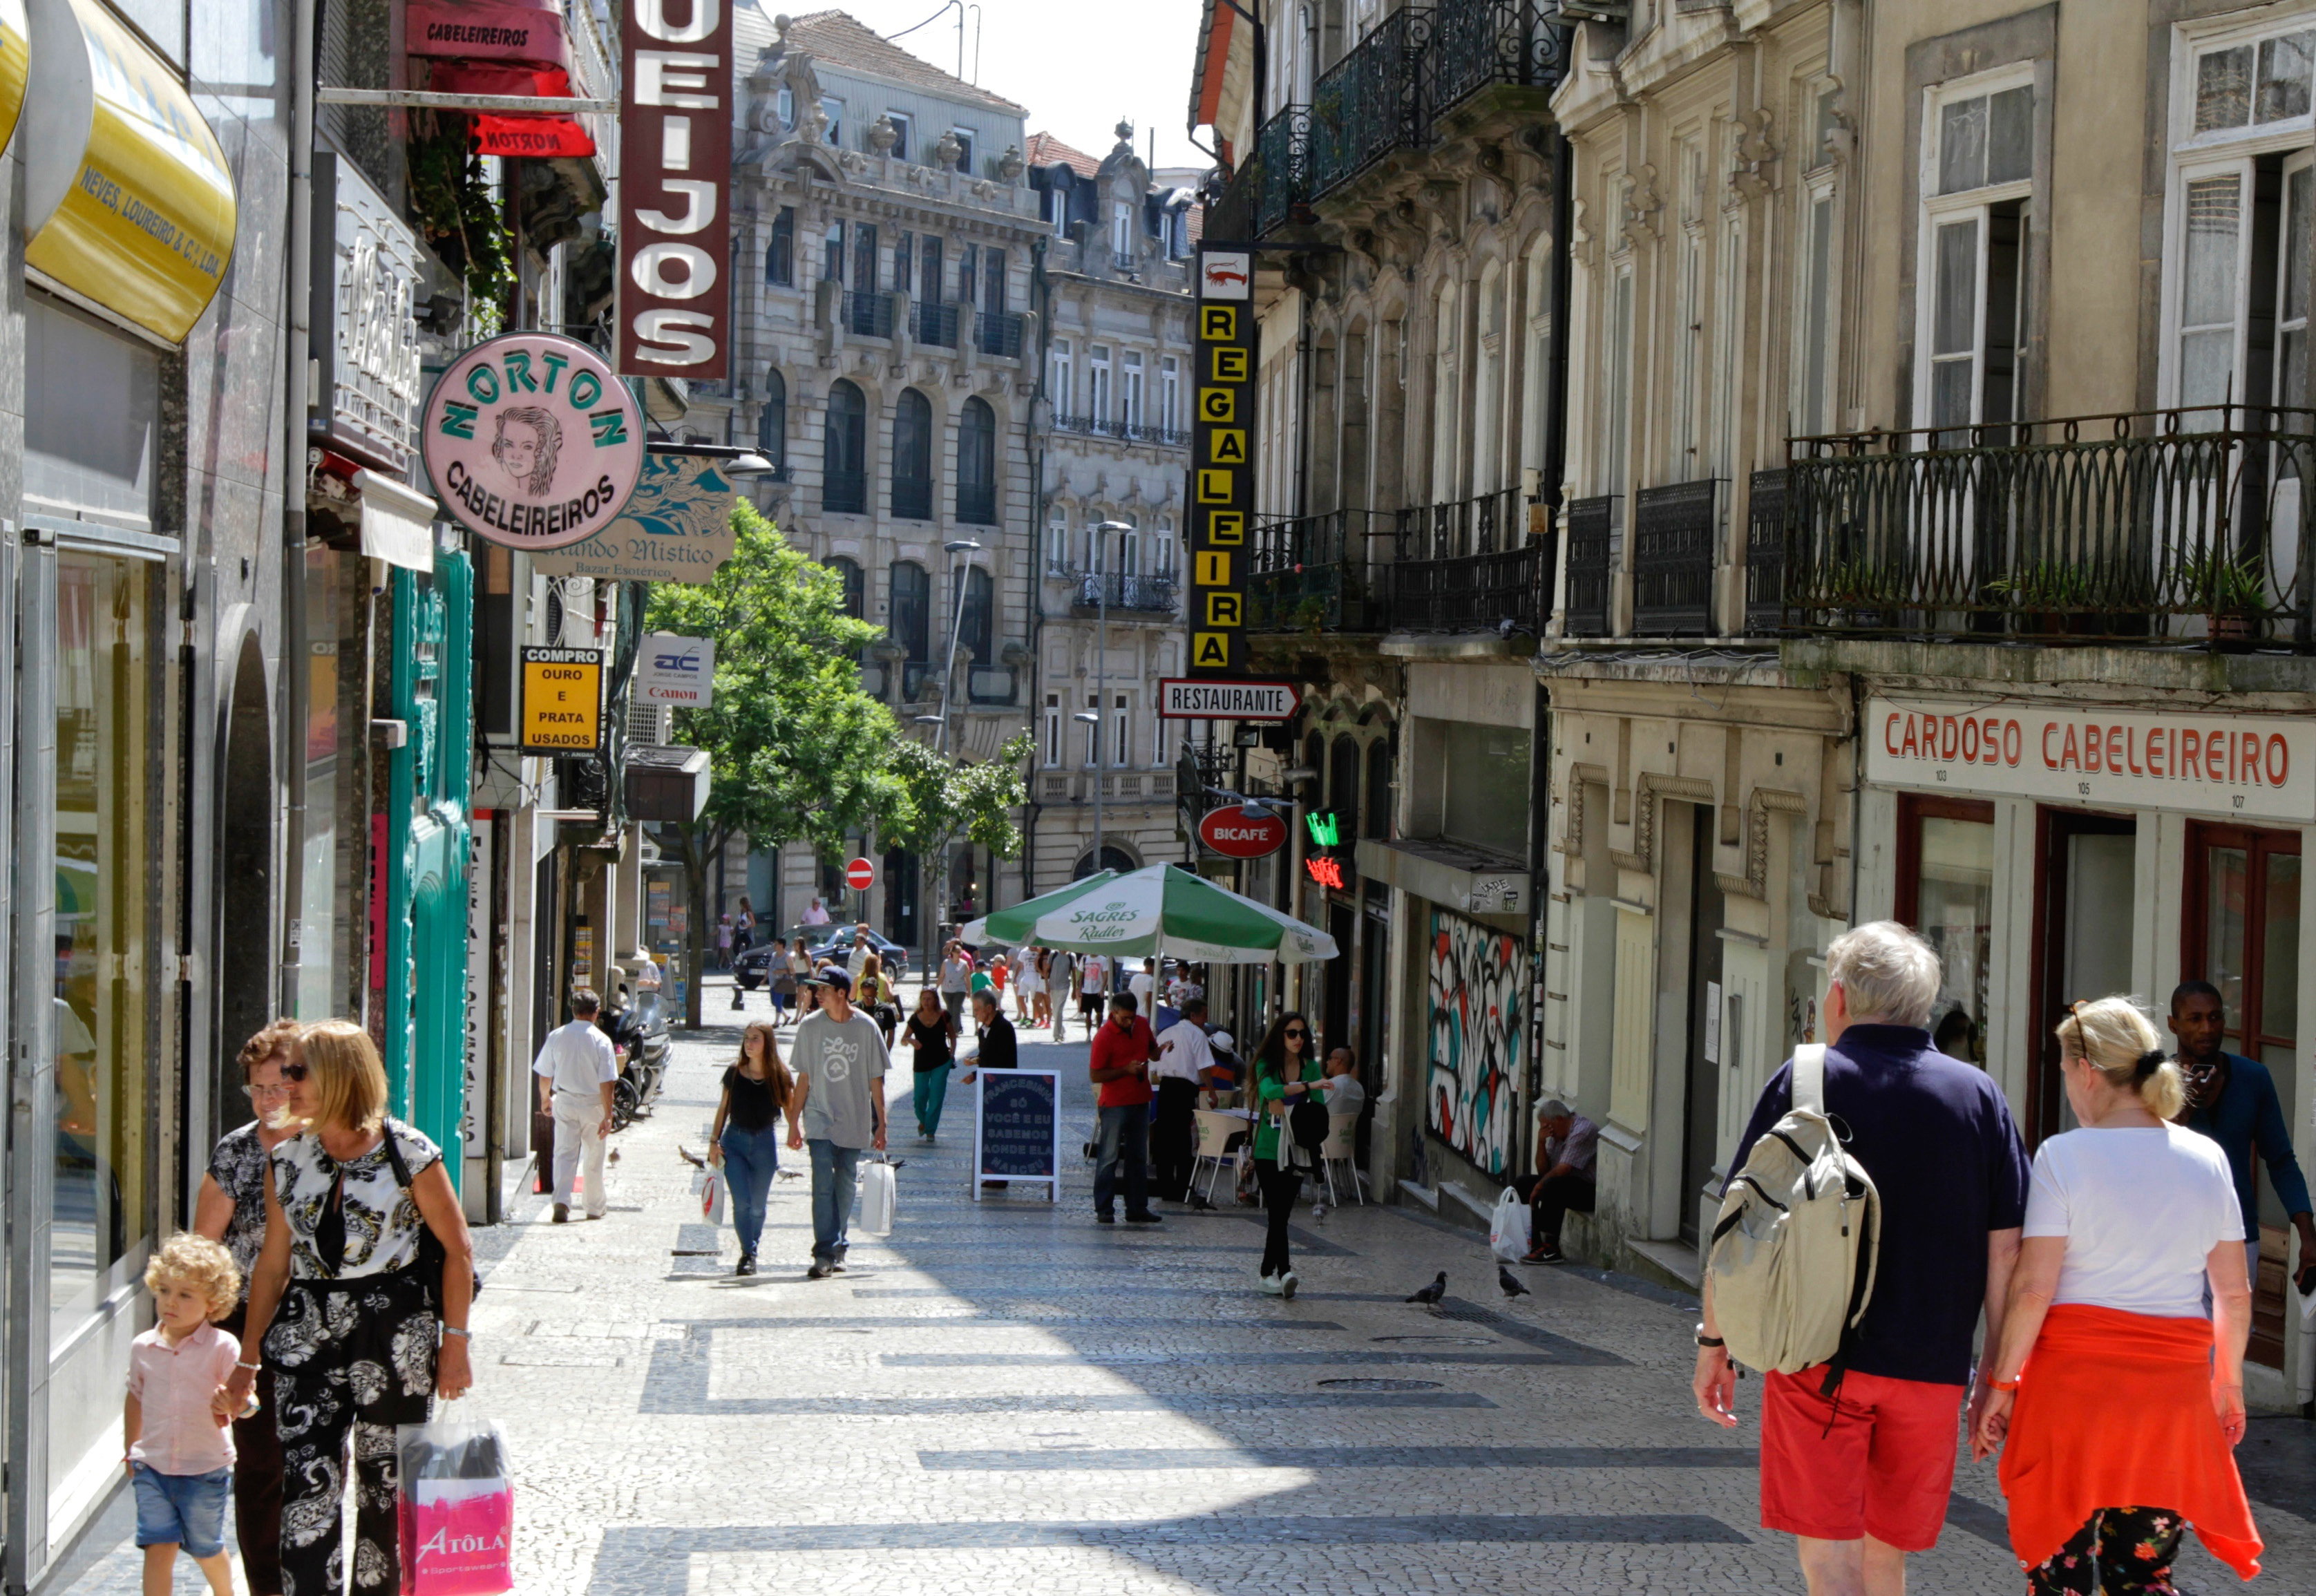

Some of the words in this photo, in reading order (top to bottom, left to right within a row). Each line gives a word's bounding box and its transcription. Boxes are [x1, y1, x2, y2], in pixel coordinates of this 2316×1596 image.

[427, 23, 529, 46] CABELEIREIROS
[632, 0, 721, 366] UEIJOS
[80, 166, 121, 214] NEVES,
[122, 196, 175, 245] LOUREIRO
[173, 232, 184, 250] &
[439, 349, 628, 449] NORTON
[1199, 309, 1244, 663] REGALEIRA
[446, 461, 615, 536] CABELEIREIROS
[576, 562, 609, 575] Bazar
[614, 564, 672, 578] Esotérico
[526, 649, 598, 663] COMPRO
[542, 669, 583, 681] OURO
[558, 691, 566, 701] E
[649, 687, 697, 700] Canon
[1173, 687, 1284, 712] RESTAURANTE
[539, 712, 584, 723] PRATA
[532, 734, 590, 745] USADOS
[1885, 712, 2023, 768] CARDOSO
[2042, 722, 2290, 788] CABELEIREIRO
[1935, 770, 1947, 782] 103
[2078, 782, 2090, 795] 105
[2232, 795, 2245, 808] 107
[1214, 827, 1269, 841] BICAFÉ
[1070, 909, 1140, 923] SAGRES
[1079, 925, 1126, 941] Radler
[985, 1112, 1020, 1123] VOCÊ
[1023, 1114, 1031, 1123] E
[1034, 1114, 1051, 1124] EU
[988, 1130, 1048, 1139] SABEMOS
[983, 1144, 1025, 1155] AONDE
[1029, 1145, 1053, 1155] ELA
[416, 1526, 506, 1564] ATÔLA
[430, 1562, 499, 1575] Sportswear
